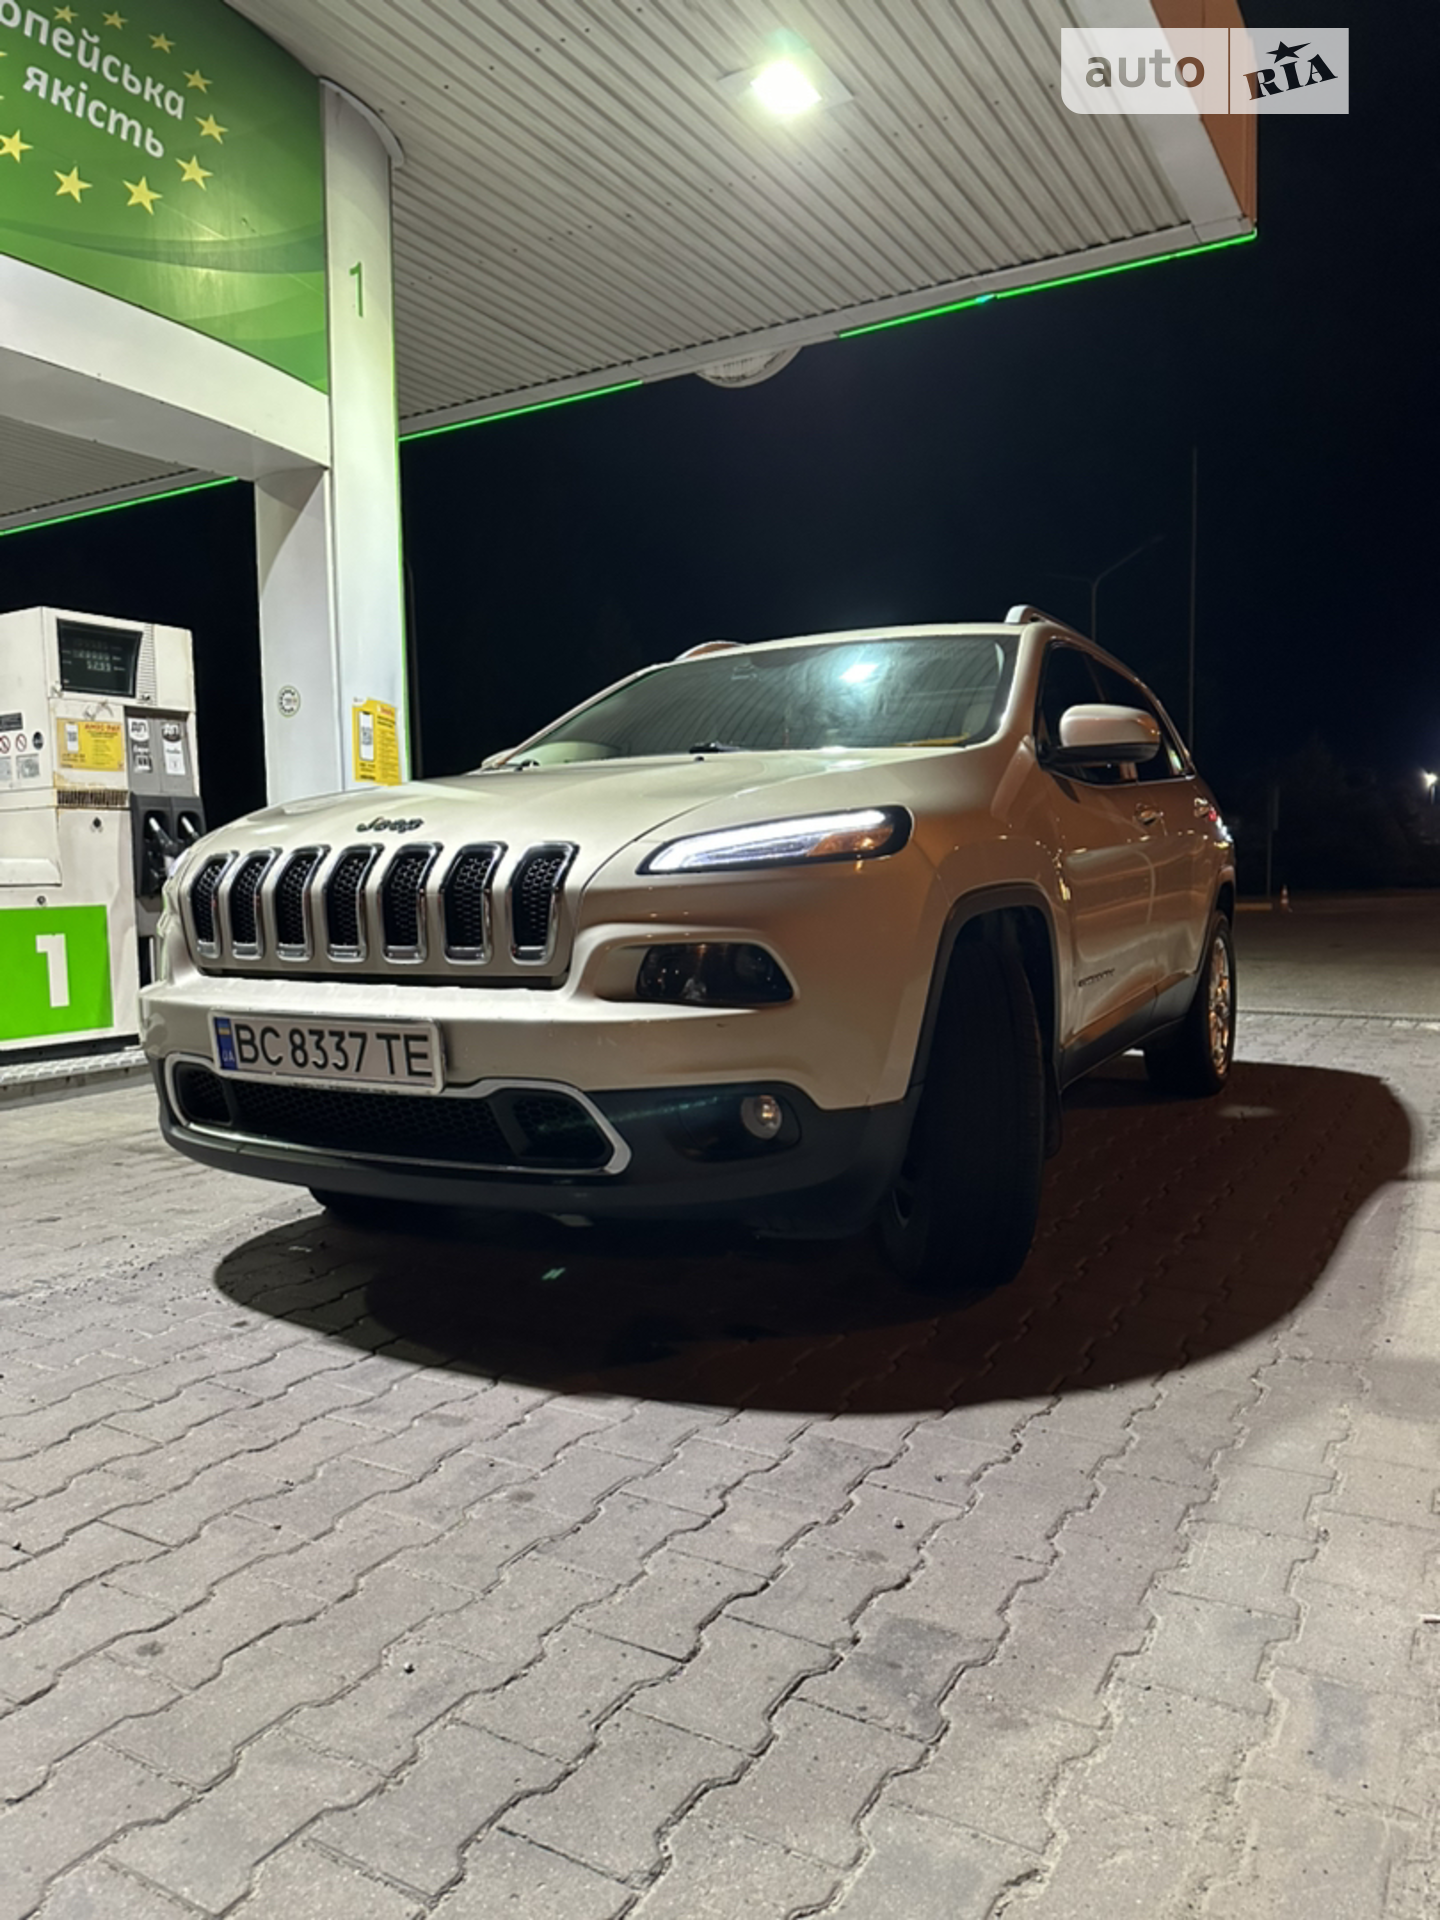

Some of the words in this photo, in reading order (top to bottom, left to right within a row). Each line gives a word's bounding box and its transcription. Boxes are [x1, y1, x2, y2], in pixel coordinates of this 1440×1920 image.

[23, 66, 165, 158] якість
[349, 262, 364, 318] 1
[356, 816, 424, 834] Jeep
[36, 933, 70, 1008] 1
[234, 1023, 284, 1066] BC
[289, 1028, 368, 1071] 8337
[375, 1032, 433, 1077] TE
